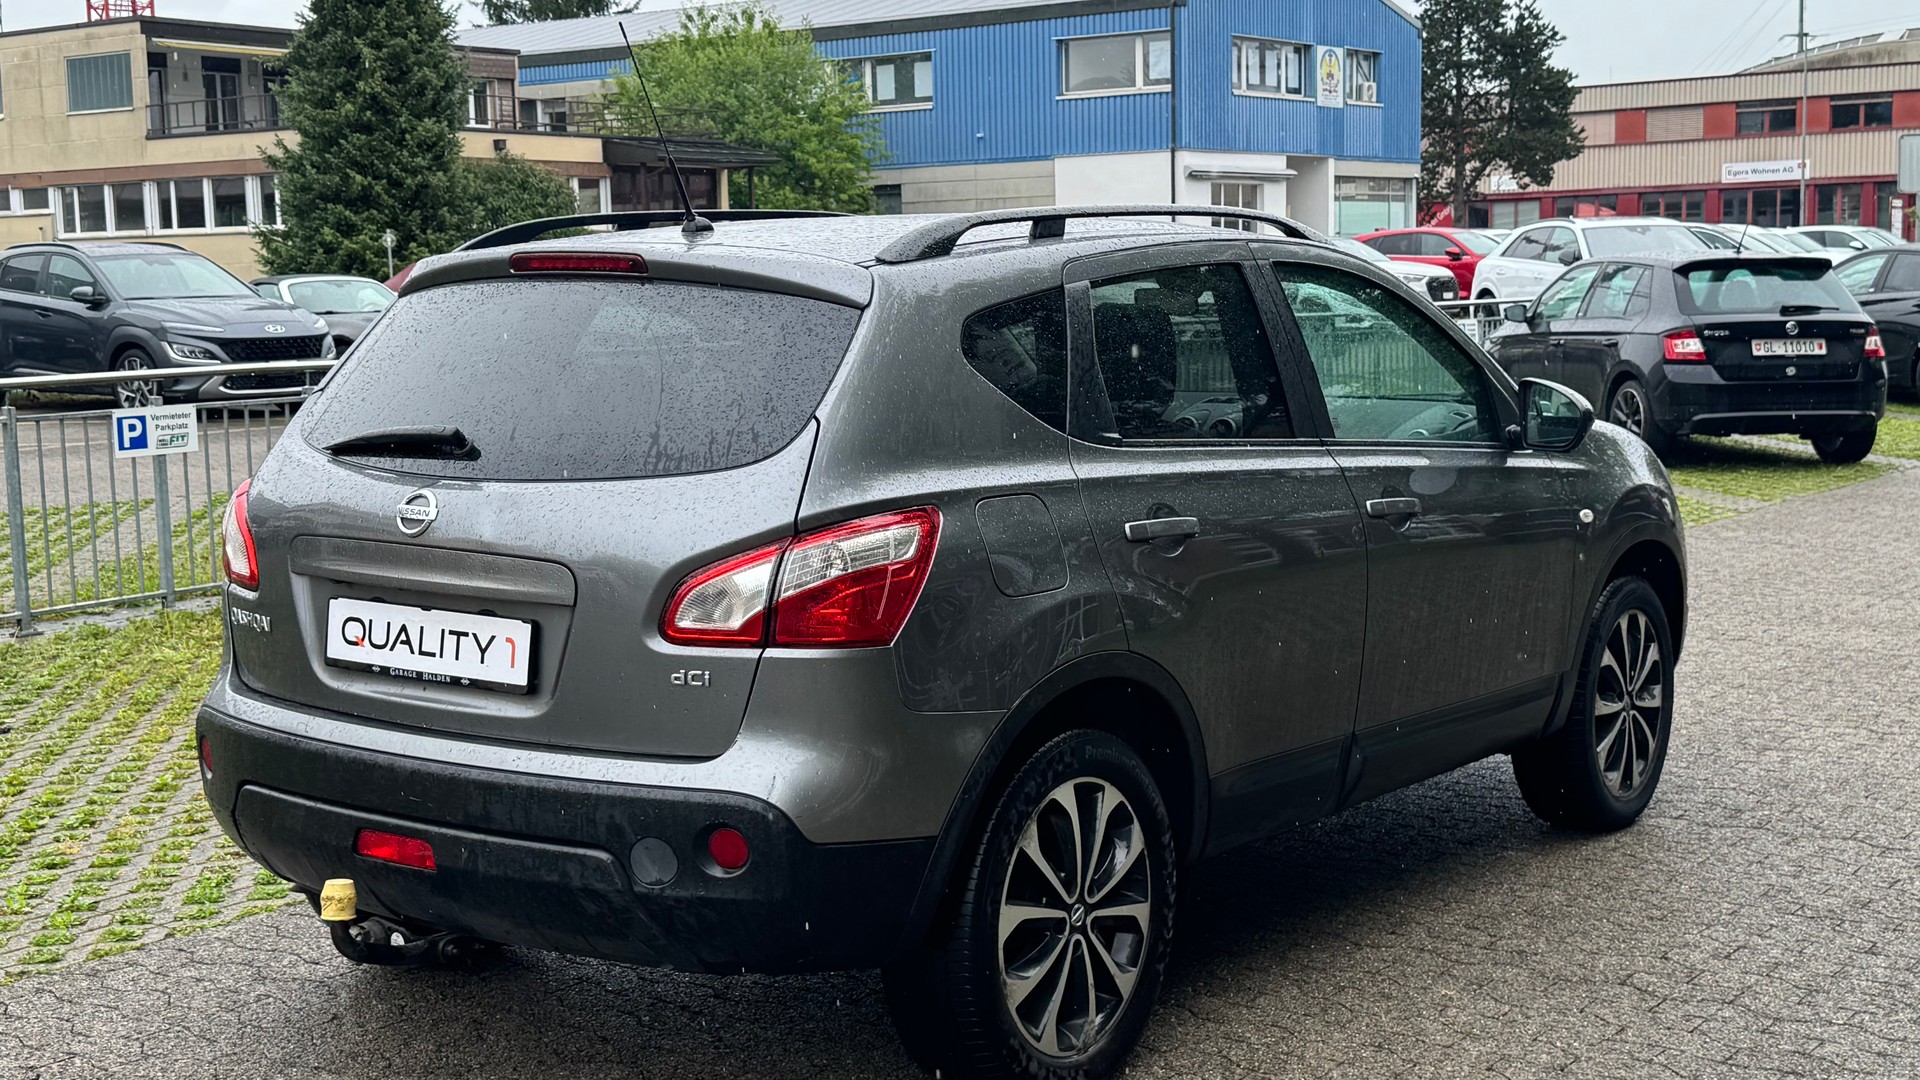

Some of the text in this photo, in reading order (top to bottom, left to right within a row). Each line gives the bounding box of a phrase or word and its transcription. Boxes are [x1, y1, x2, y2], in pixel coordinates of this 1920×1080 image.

[1750, 167, 1781, 175] Wohnen
[1782, 166, 1794, 174] AG
[150, 412, 192, 422] Vermieteter
[121, 418, 143, 448] P
[155, 422, 189, 432] Parkplatz
[169, 434, 187, 446] FIT
[398, 506, 431, 518] NISSAN
[341, 616, 497, 665] QUALITY
[389, 667, 451, 683] GARAGE HALDEN
[670, 669, 711, 687] dCi
